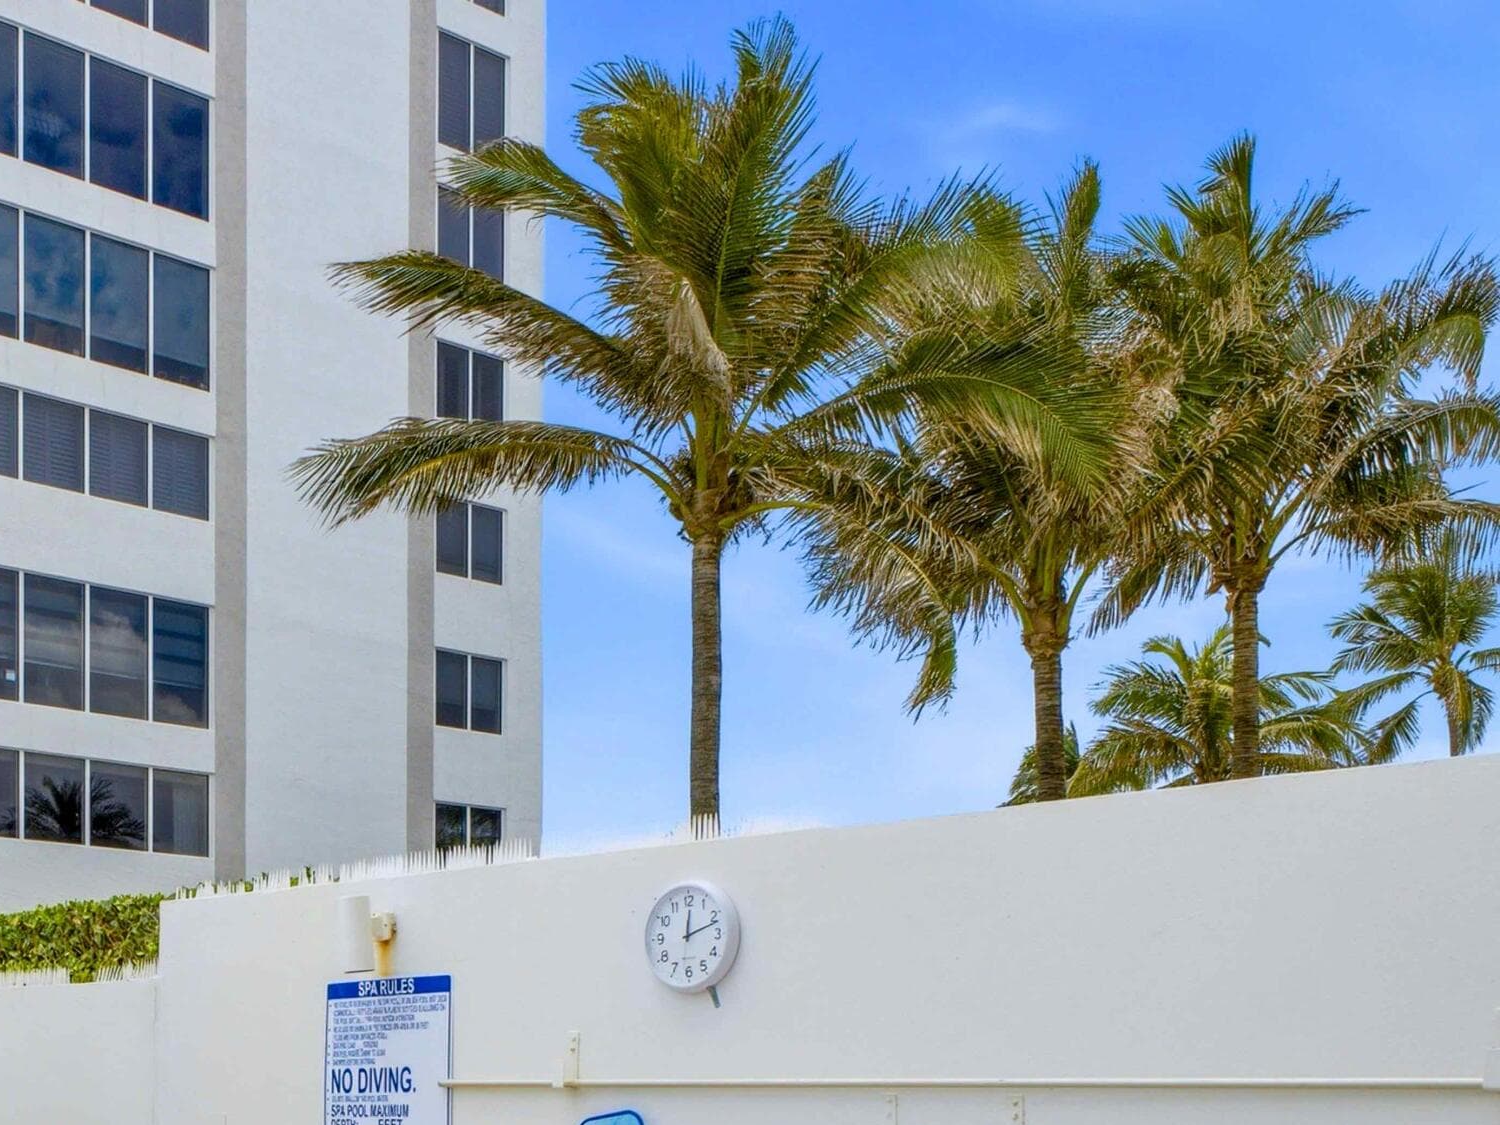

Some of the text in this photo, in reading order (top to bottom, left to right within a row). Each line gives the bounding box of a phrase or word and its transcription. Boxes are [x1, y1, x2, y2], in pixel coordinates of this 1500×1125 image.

[684, 895, 694, 907] 12
[701, 899, 705, 910] 1
[671, 902, 679, 914] 11
[660, 915, 671, 927] 10
[710, 910, 718, 923] 2
[657, 933, 665, 945] 9
[714, 928, 722, 940] 3
[661, 950, 669, 963] 8
[709, 945, 717, 957] 4
[671, 962, 679, 975] 7
[685, 966, 693, 978] 6
[699, 960, 708, 972] 5
[358, 978, 415, 997] SPA RULES
[331, 1066, 416, 1094] NO DIVING.
[331, 1104, 409, 1117] SPA POOL MAXIMUM
